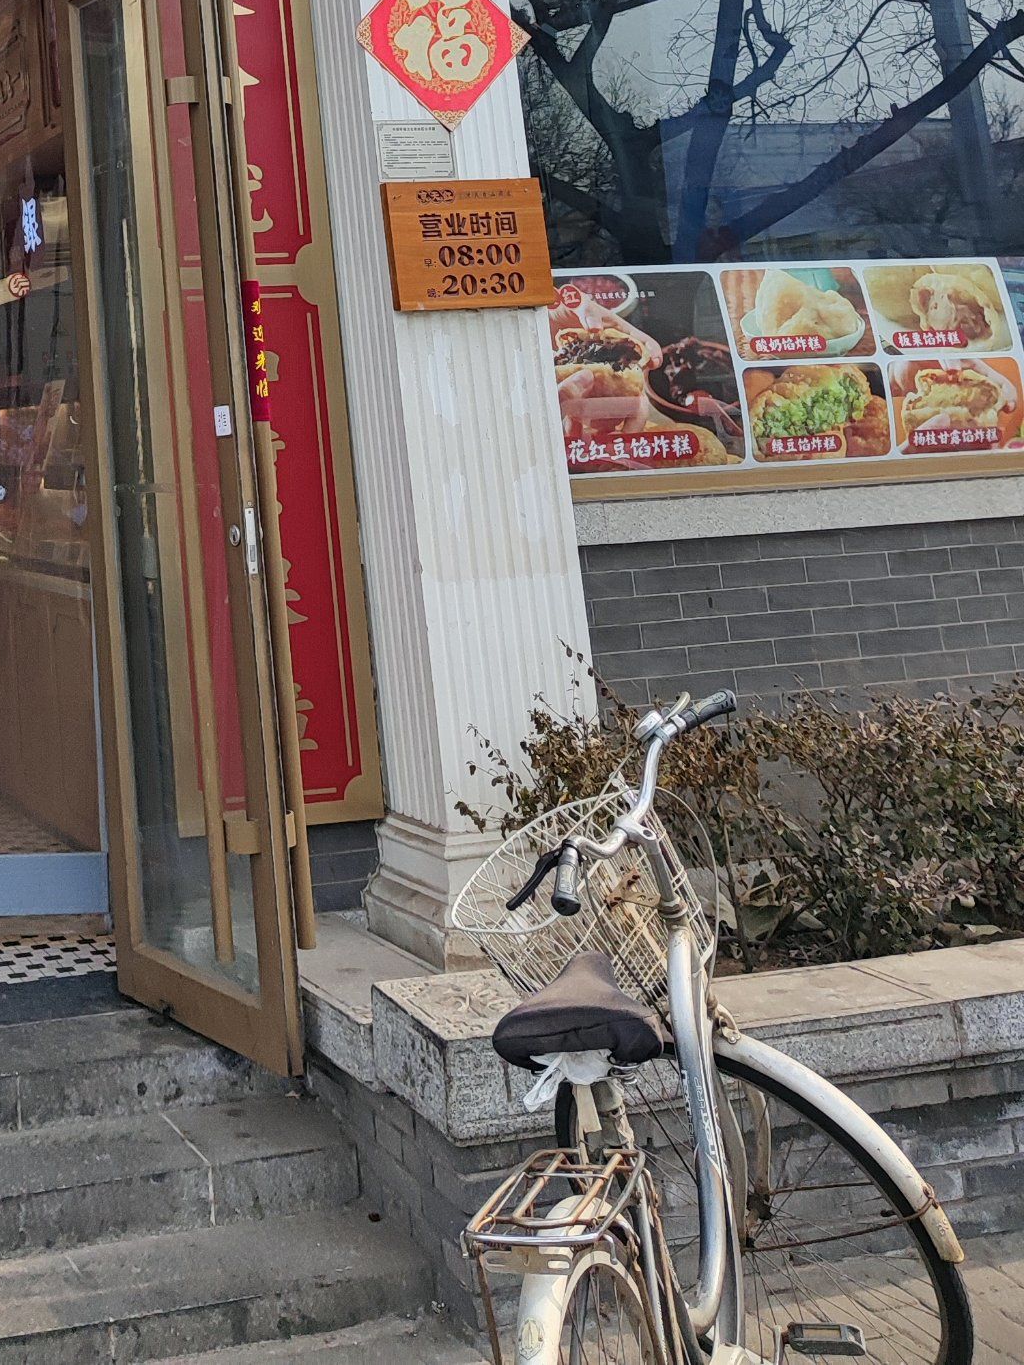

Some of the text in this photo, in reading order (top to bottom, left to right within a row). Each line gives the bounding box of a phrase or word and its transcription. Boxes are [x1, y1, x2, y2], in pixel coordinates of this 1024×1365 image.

[418, 212, 517, 238] 营业时间
[439, 244, 520, 267] 08:00
[442, 272, 525, 295] 20:30
[755, 336, 822, 353] 酸奶馅炸糕
[771, 436, 837, 453] 绿豆馅炸糕
[913, 428, 998, 446] 杨枝甘露馅炸糕
